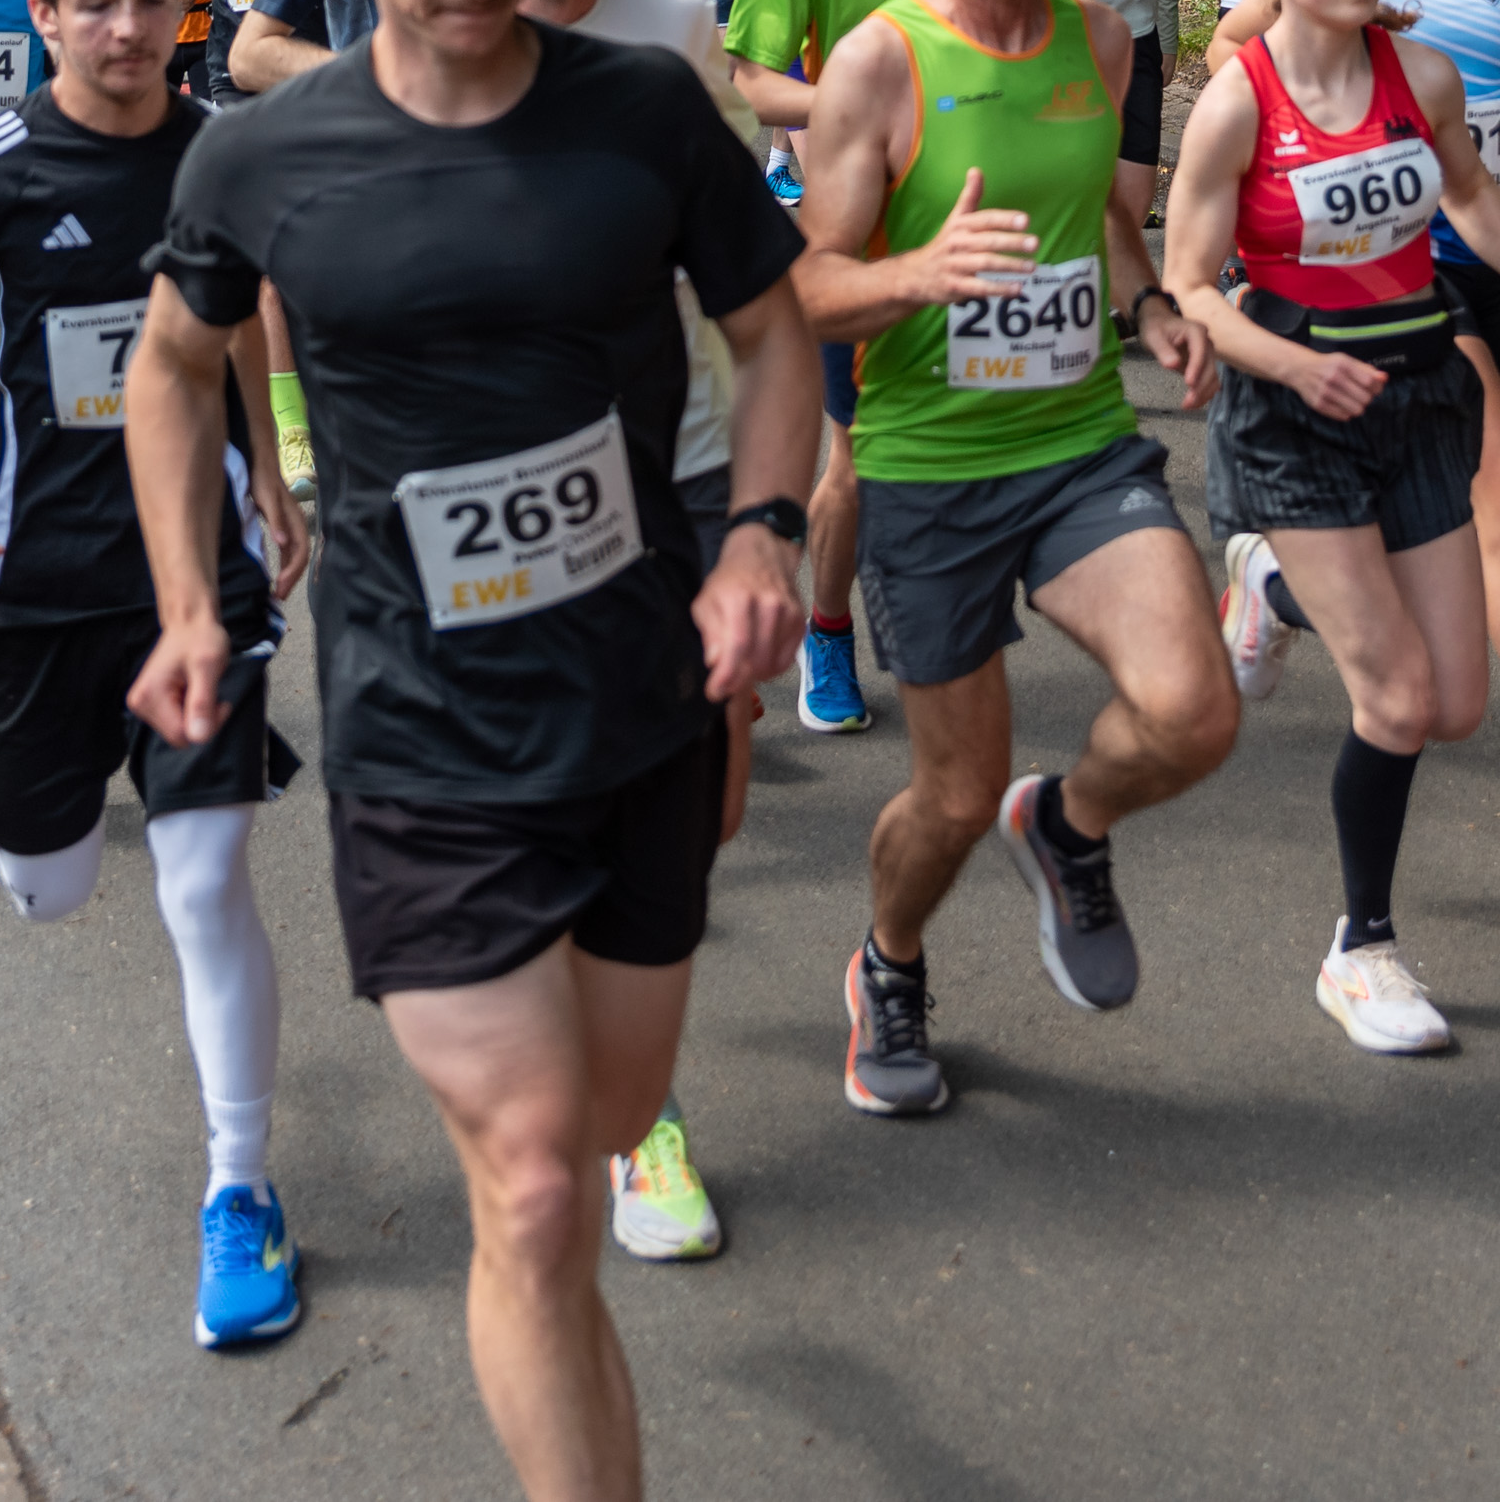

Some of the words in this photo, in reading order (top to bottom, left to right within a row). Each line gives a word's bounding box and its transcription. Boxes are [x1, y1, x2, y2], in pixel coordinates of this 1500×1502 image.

[1324, 164, 1422, 226] 960
[1317, 233, 1372, 256] EWE
[953, 282, 1096, 338] 2640
[964, 356, 1028, 378] EWE
[75, 393, 123, 418] EW
[444, 466, 601, 558] 269
[451, 567, 533, 610] EWE
